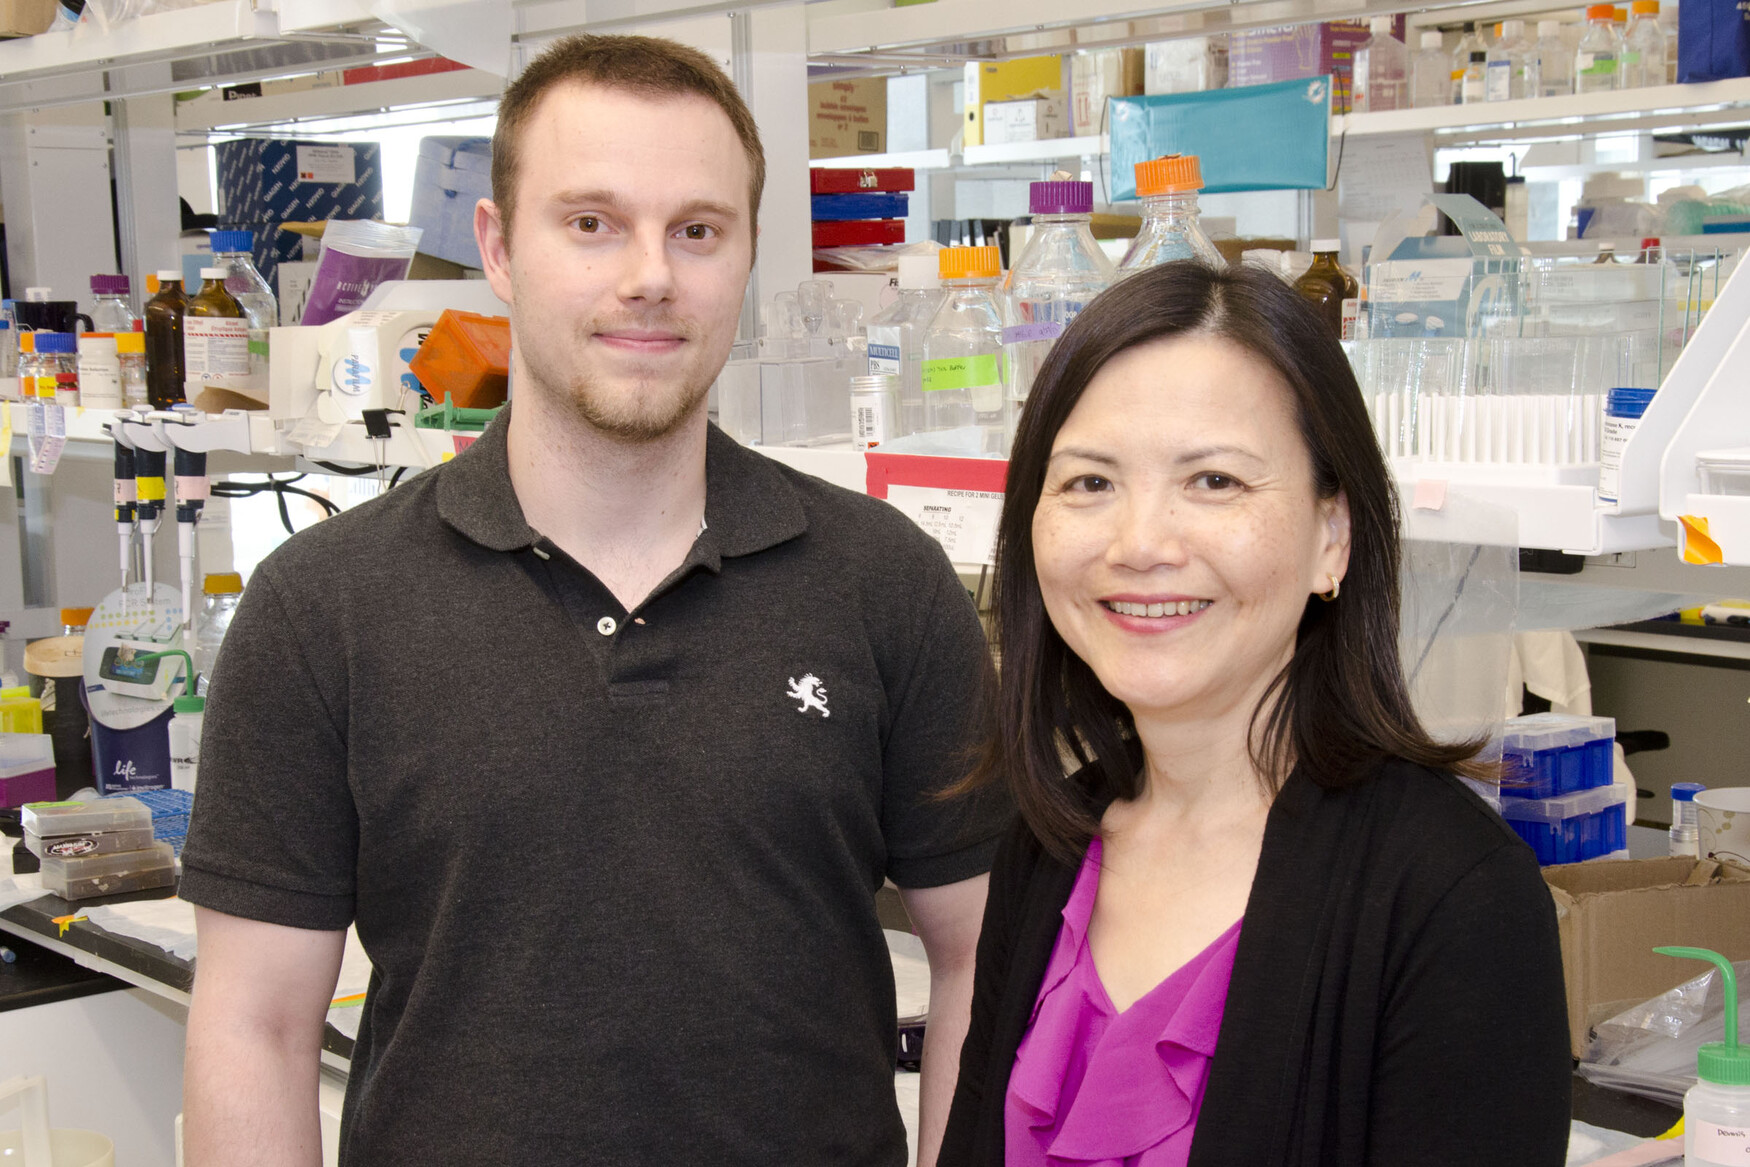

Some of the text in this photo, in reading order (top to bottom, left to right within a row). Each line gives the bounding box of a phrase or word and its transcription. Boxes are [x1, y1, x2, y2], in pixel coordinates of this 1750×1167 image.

[271, 153, 290, 175] QIAGEN
[264, 181, 283, 202] QIAGEN
[306, 187, 325, 209] QIAGEN
[281, 198, 300, 219] QIAGEN
[347, 194, 366, 216] QIAGEN
[1468, 231, 1510, 243] LABORATORY
[1487, 244, 1506, 256] FILM
[869, 345, 898, 358] MULTICELL
[351, 353, 361, 392] PARAFILM
[870, 360, 880, 371] PBS
[947, 490, 965, 498] RECIPE
[113, 760, 137, 782] life
[1717, 1128, 1746, 1138] Dennis
